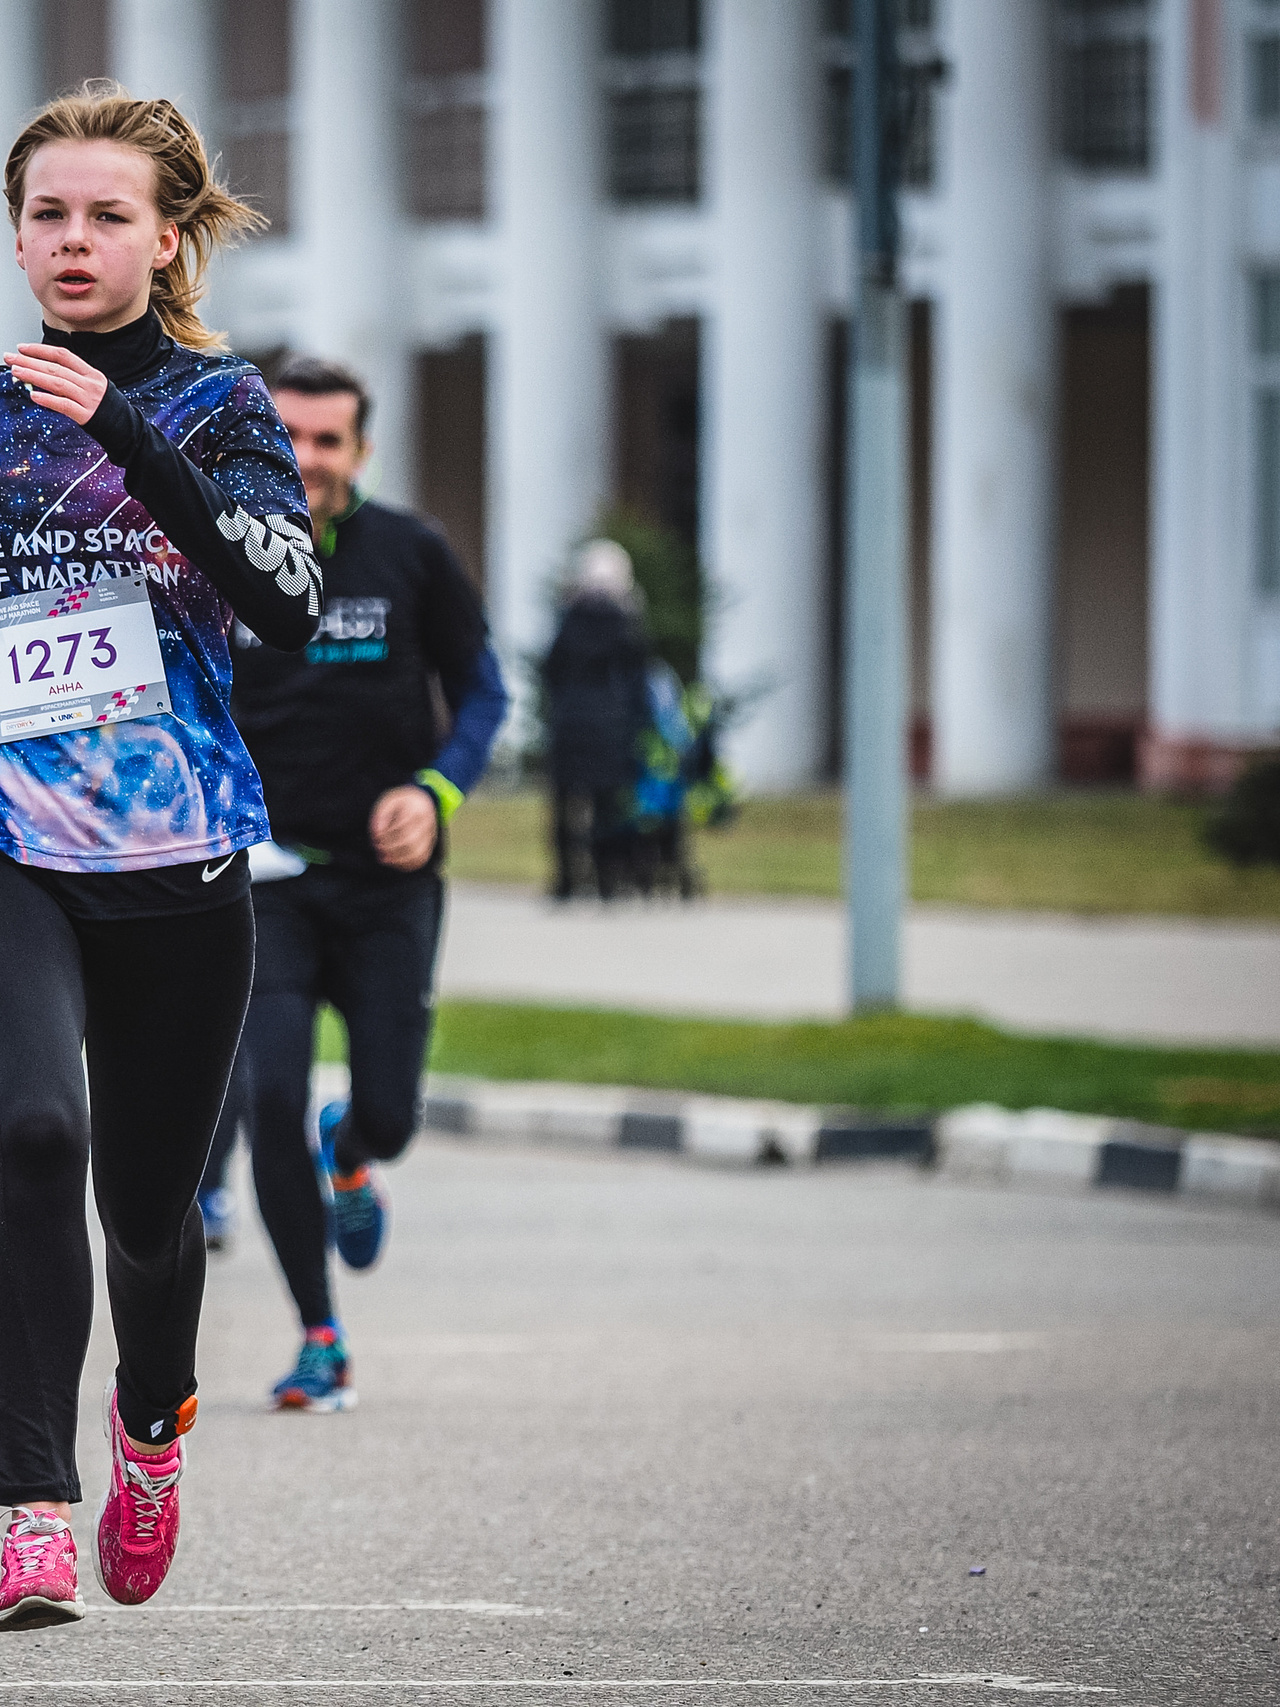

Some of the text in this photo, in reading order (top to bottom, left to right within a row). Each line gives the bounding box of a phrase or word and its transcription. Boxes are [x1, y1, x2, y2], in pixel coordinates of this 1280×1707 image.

[11, 529, 76, 557] AND
[21, 560, 181, 590] MARATHON
[7, 603, 20, 613] AND
[19, 600, 40, 611] SPACE
[8, 607, 41, 620] MARATHON
[158, 629, 183, 641] PAC
[7, 626, 118, 685] 1273
